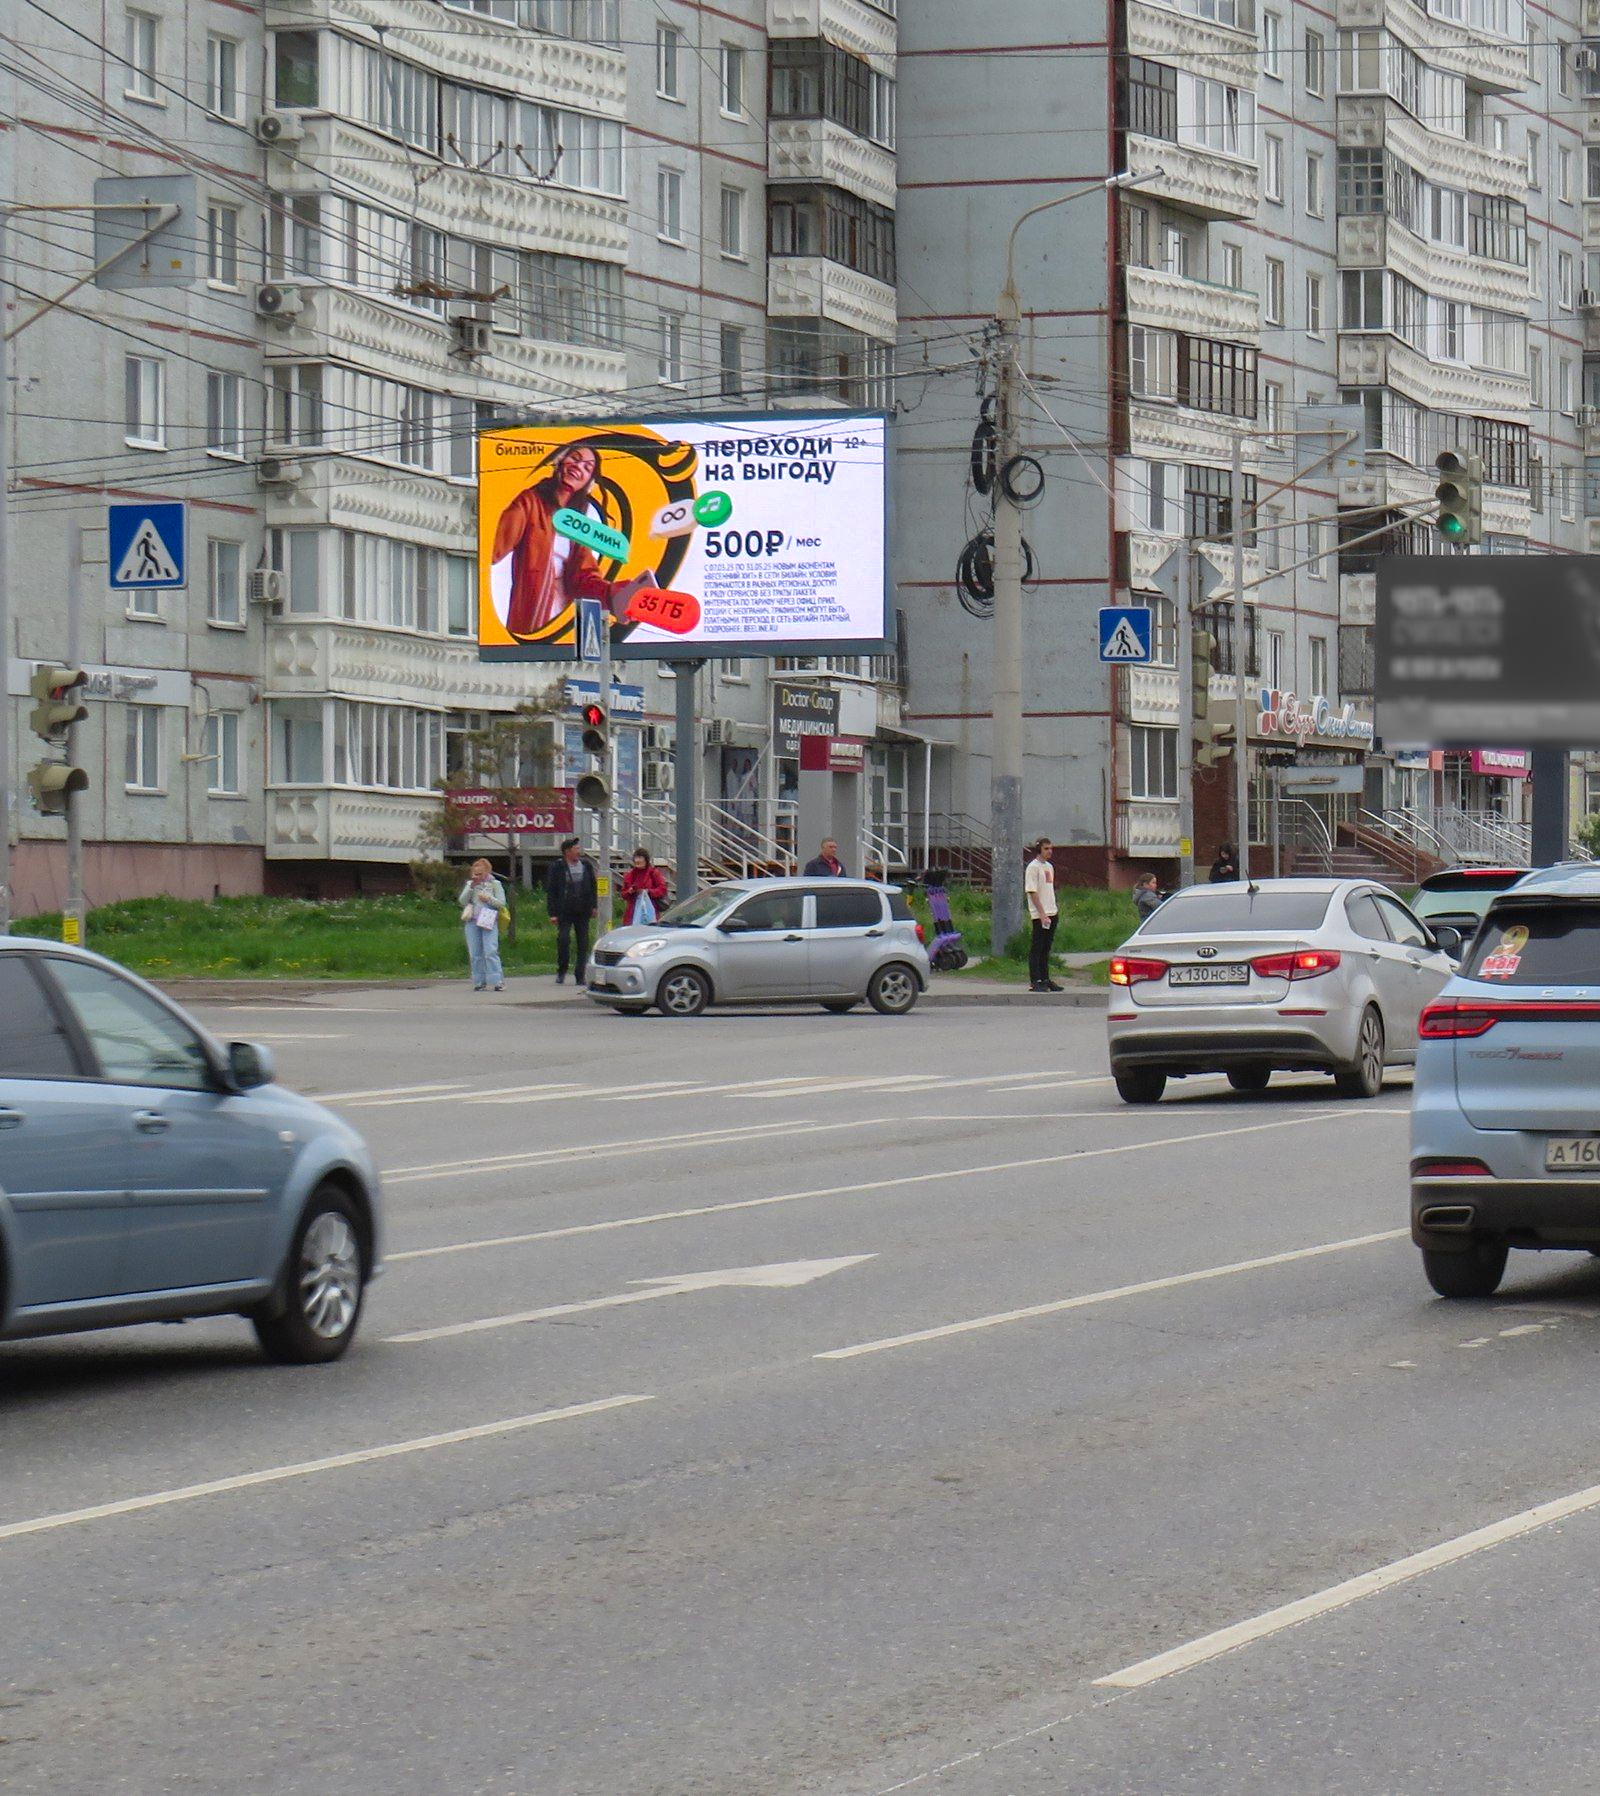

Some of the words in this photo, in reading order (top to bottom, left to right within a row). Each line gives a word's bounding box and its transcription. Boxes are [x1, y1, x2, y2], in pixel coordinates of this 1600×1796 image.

[705, 437, 833, 463] переходи
[705, 463, 735, 482] на
[743, 461, 837, 485] выгоду
[562, 514, 591, 535] 200
[593, 529, 621, 549] мин
[796, 536, 822, 547] мес
[638, 594, 659, 612] 35
[661, 601, 685, 620] ГБ
